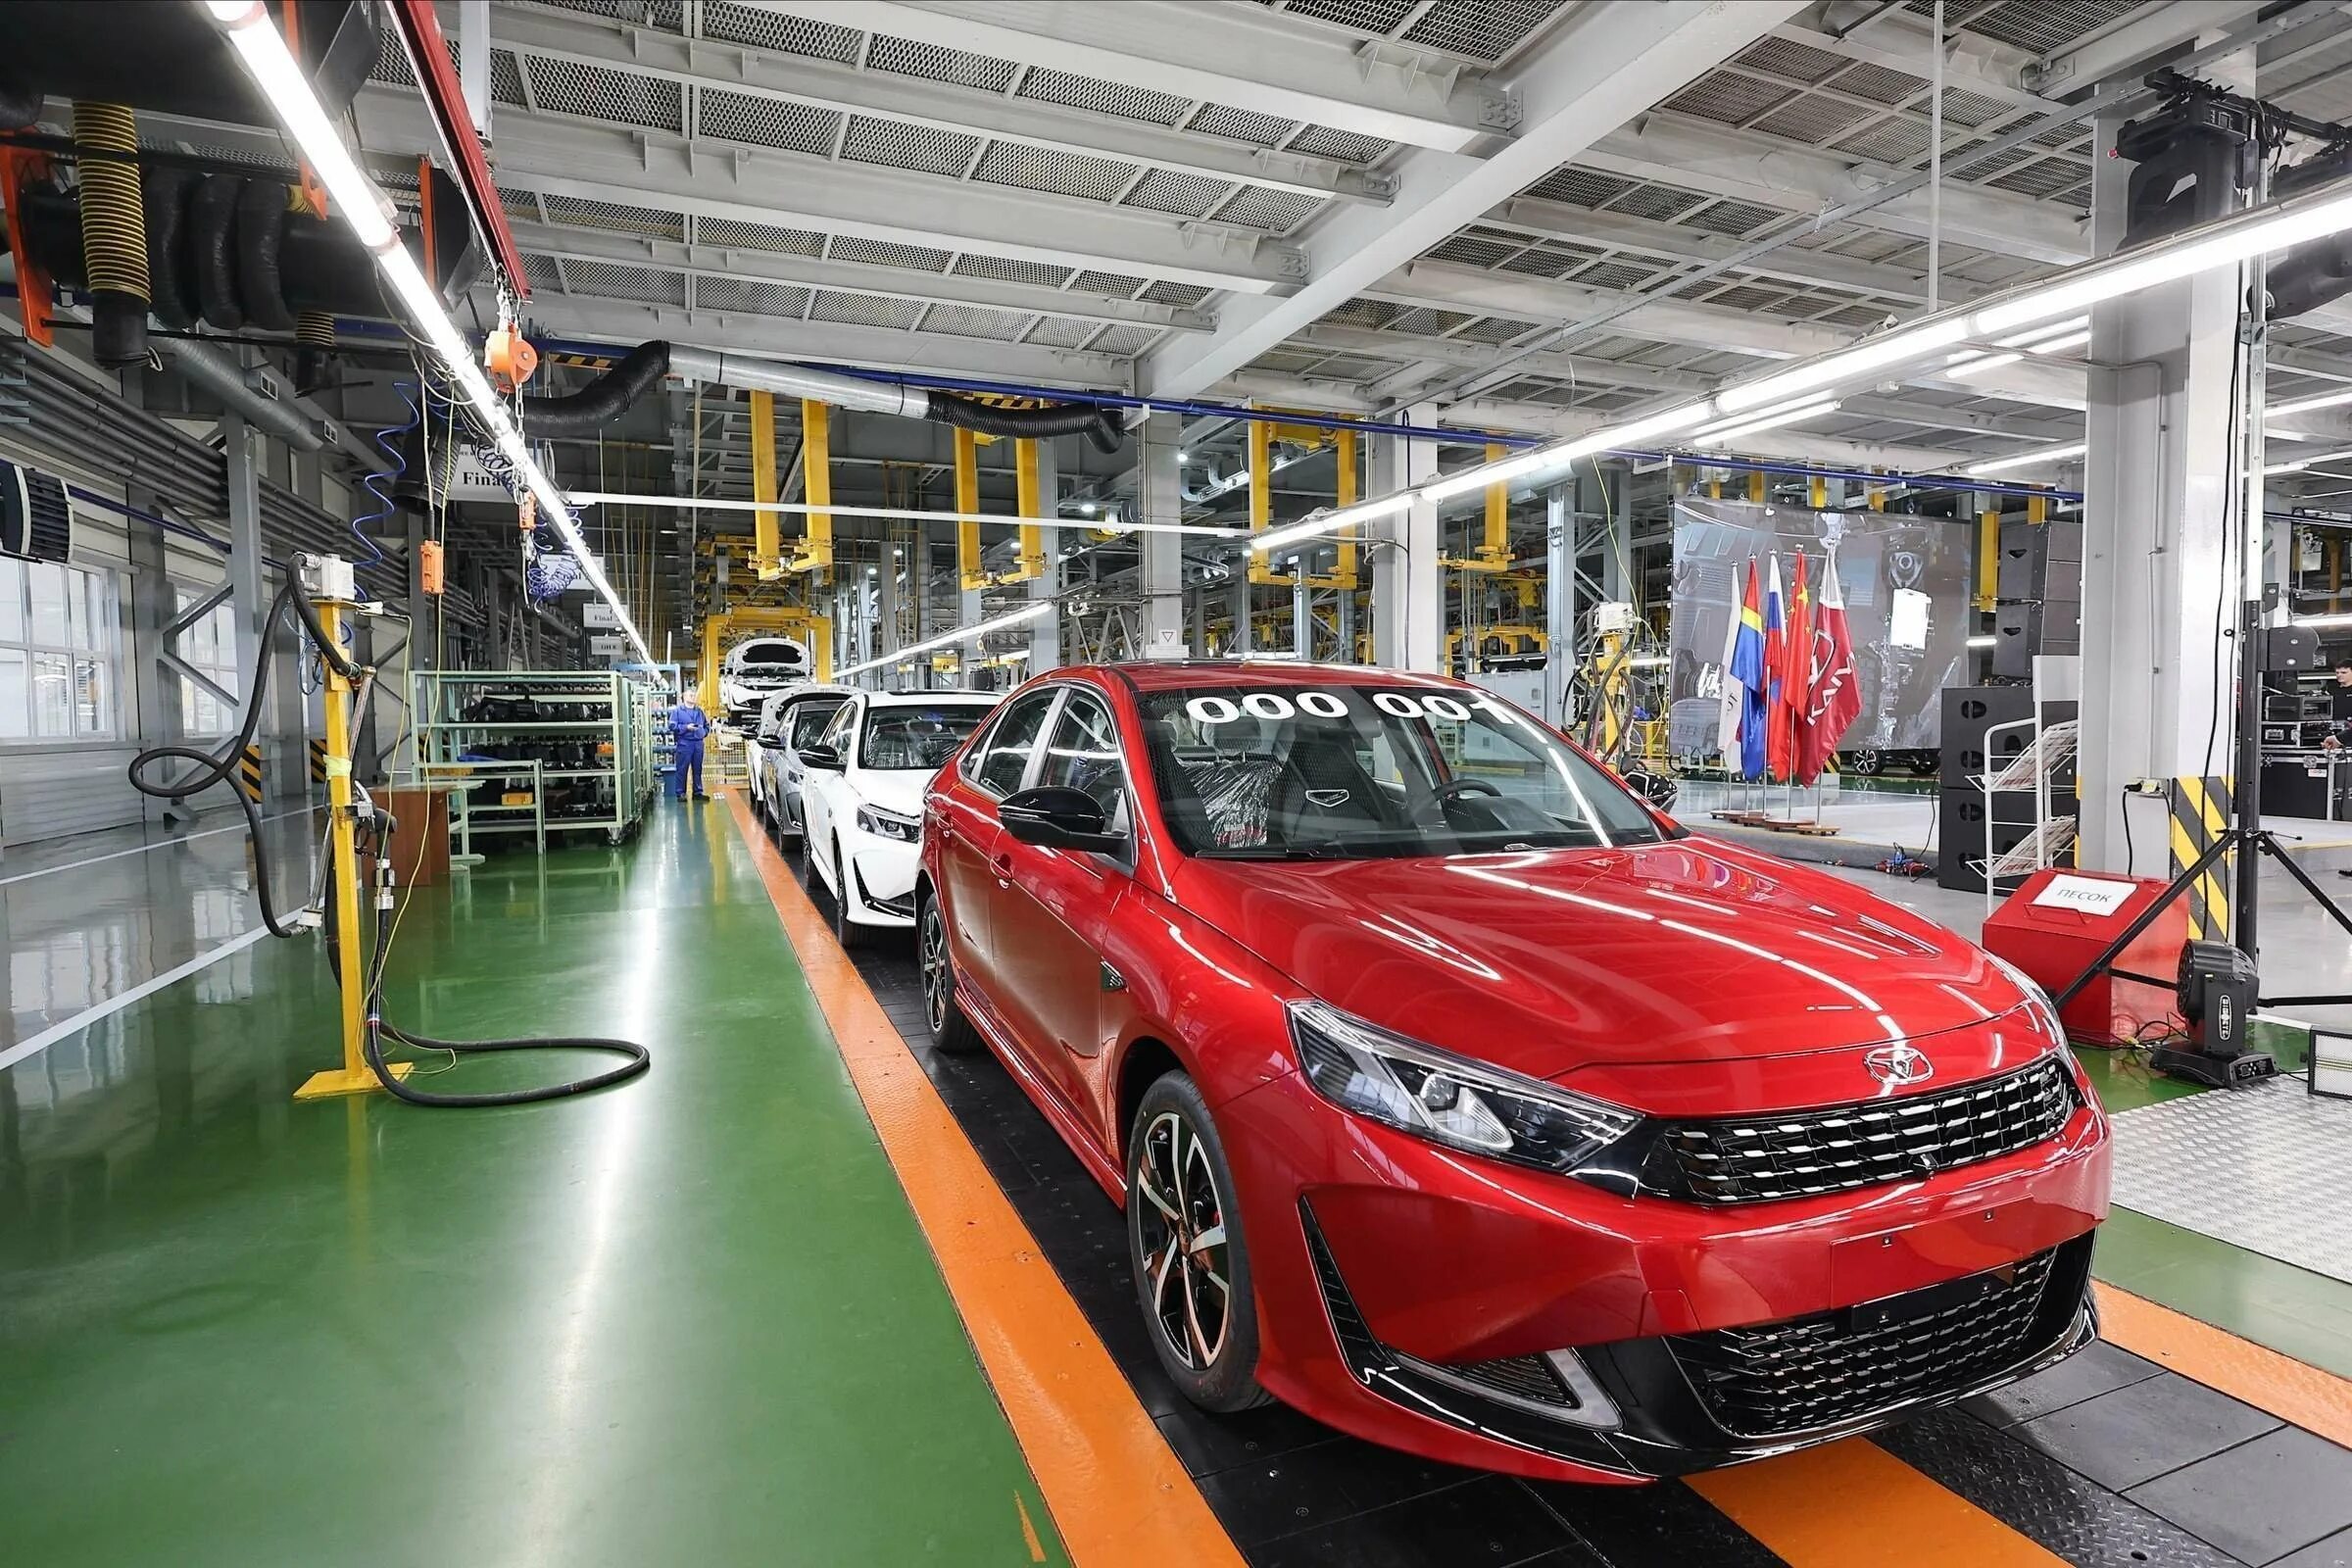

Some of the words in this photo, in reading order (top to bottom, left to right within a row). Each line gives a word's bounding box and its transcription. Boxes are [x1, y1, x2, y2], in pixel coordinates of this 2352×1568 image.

[463, 471, 503, 486] Fina
[1186, 692, 1348, 723] 000
[1372, 692, 1515, 725] 001
[2058, 889, 2112, 902] ПЕСОК
